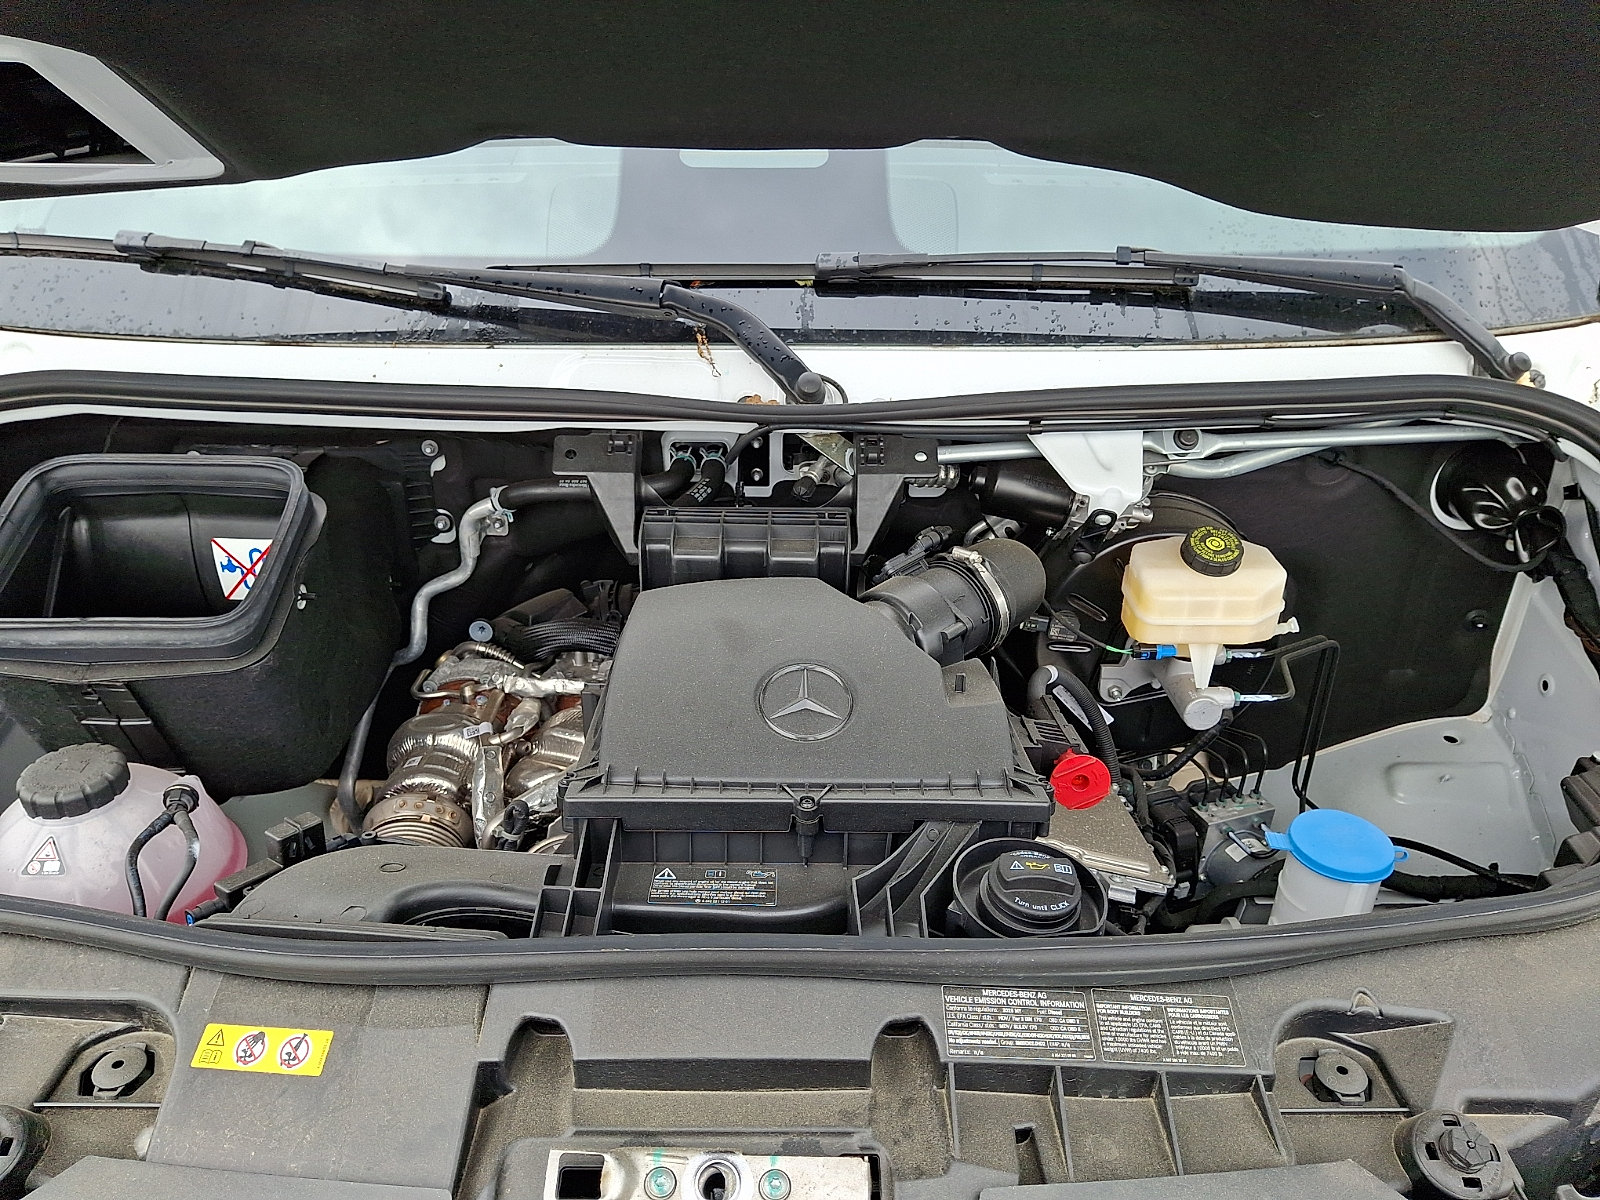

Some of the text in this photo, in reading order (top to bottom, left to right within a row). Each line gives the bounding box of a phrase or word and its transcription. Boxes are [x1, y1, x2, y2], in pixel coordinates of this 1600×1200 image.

[1014, 896, 1030, 908] Turn
[1050, 900, 1070, 911] CLICK
[982, 989, 1036, 998] MERCEDES-BENZ
[1130, 993, 1193, 1004] MERCEDES-BENZ AG
[945, 995, 1085, 1009] VEHICLE EMISSION CONTROL INFORMATION
